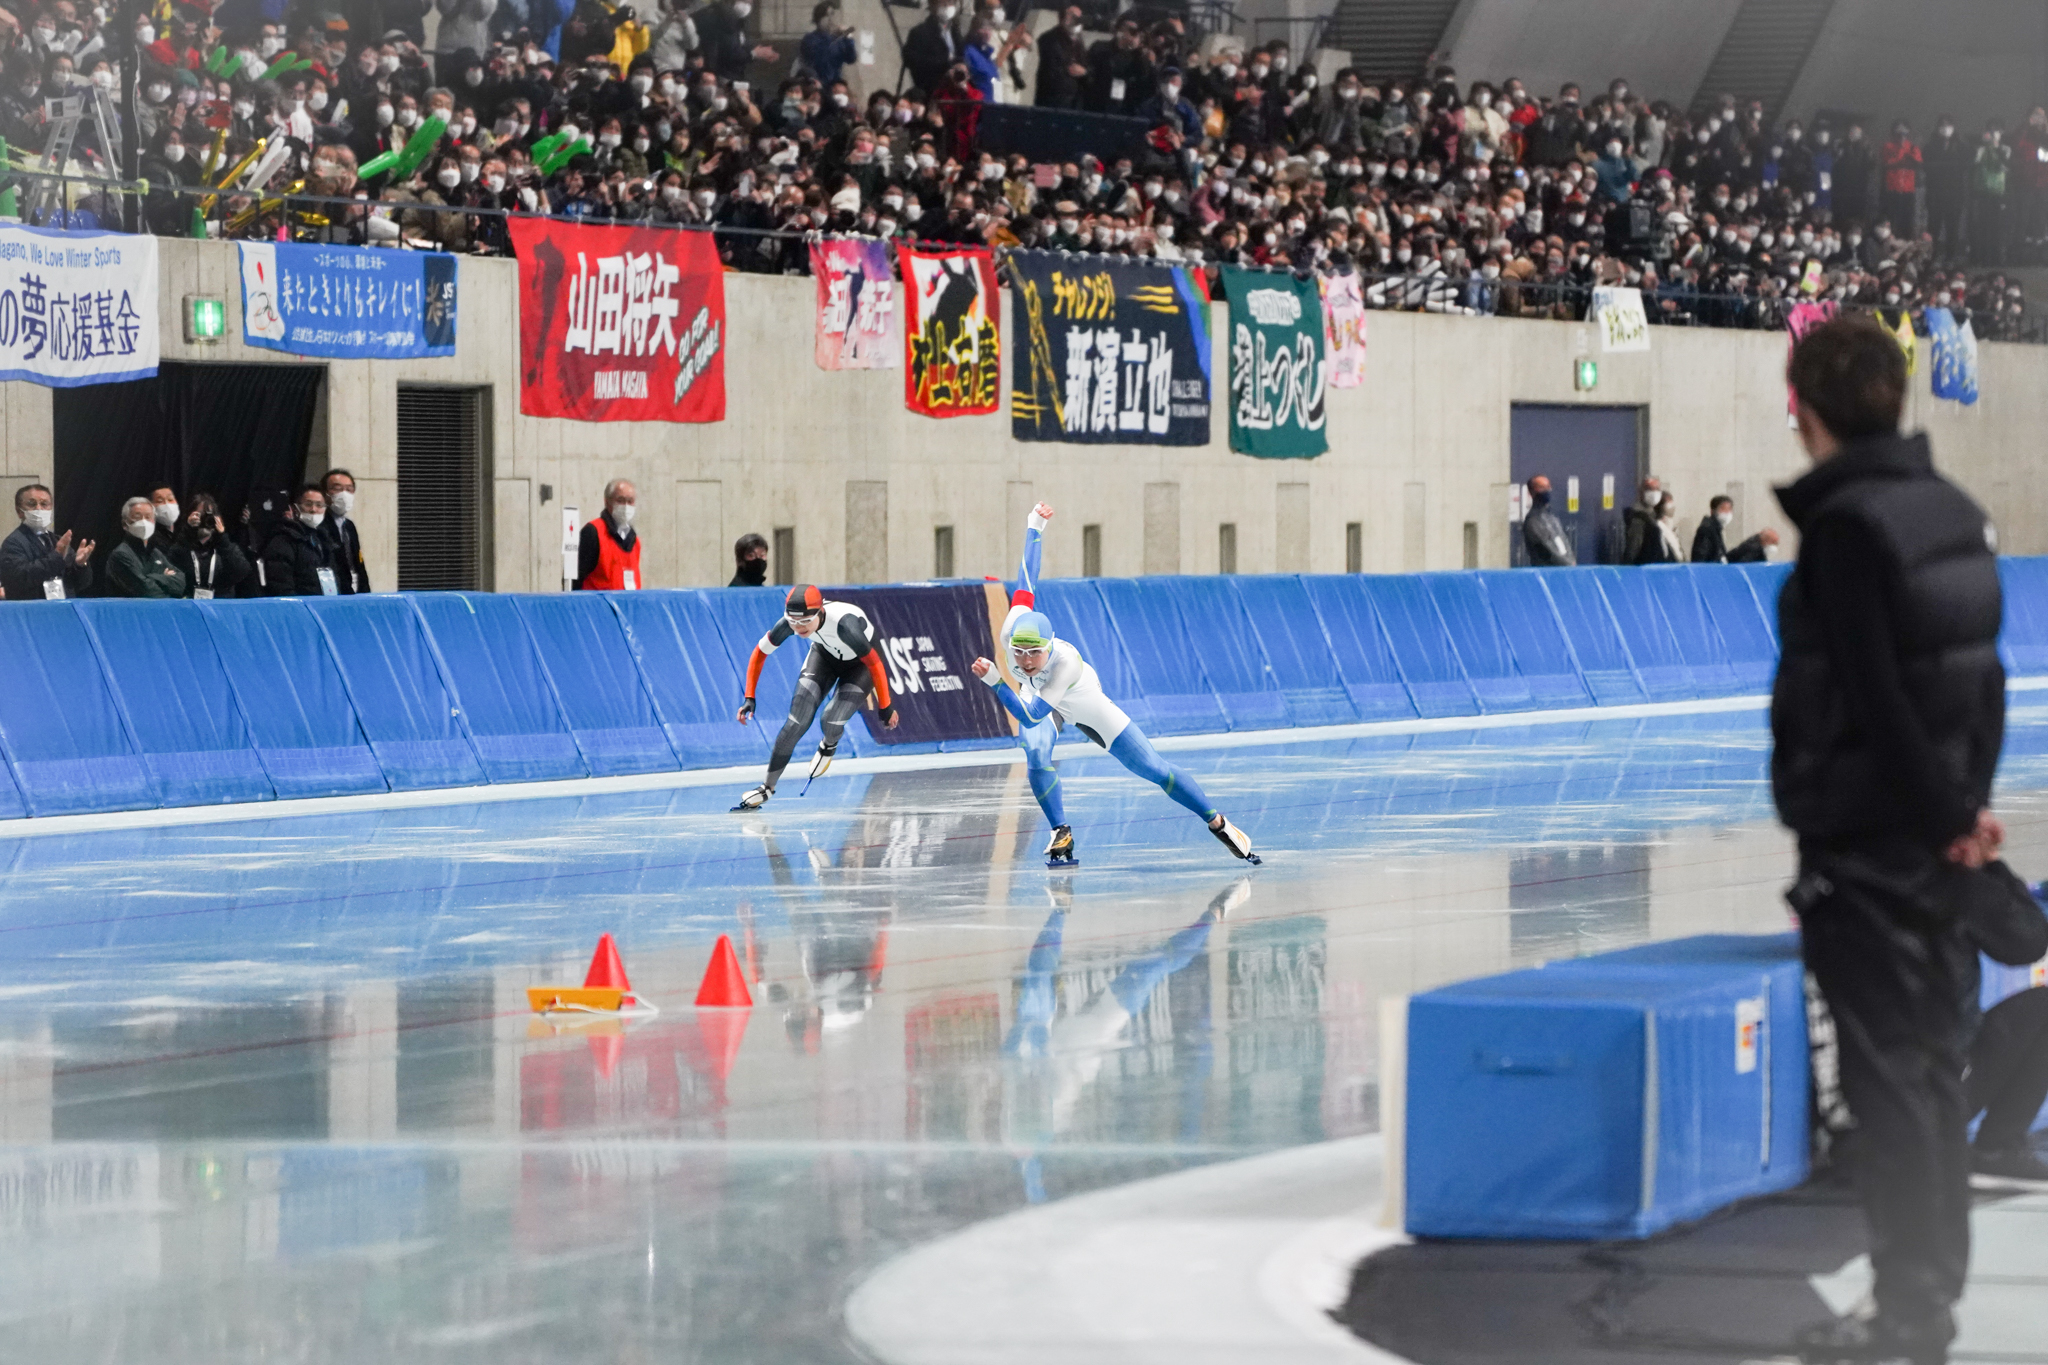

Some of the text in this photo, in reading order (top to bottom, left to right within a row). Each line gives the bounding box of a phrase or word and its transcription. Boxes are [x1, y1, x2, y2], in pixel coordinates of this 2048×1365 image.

[30, 242, 42, 265] We
[45, 245, 63, 267] Love
[65, 248, 92, 268] Winter
[94, 246, 121, 269] Sports
[0, 272, 140, 361] の夢応援基金
[565, 251, 679, 358] 山田将矢
[880, 637, 925, 695] JSF
